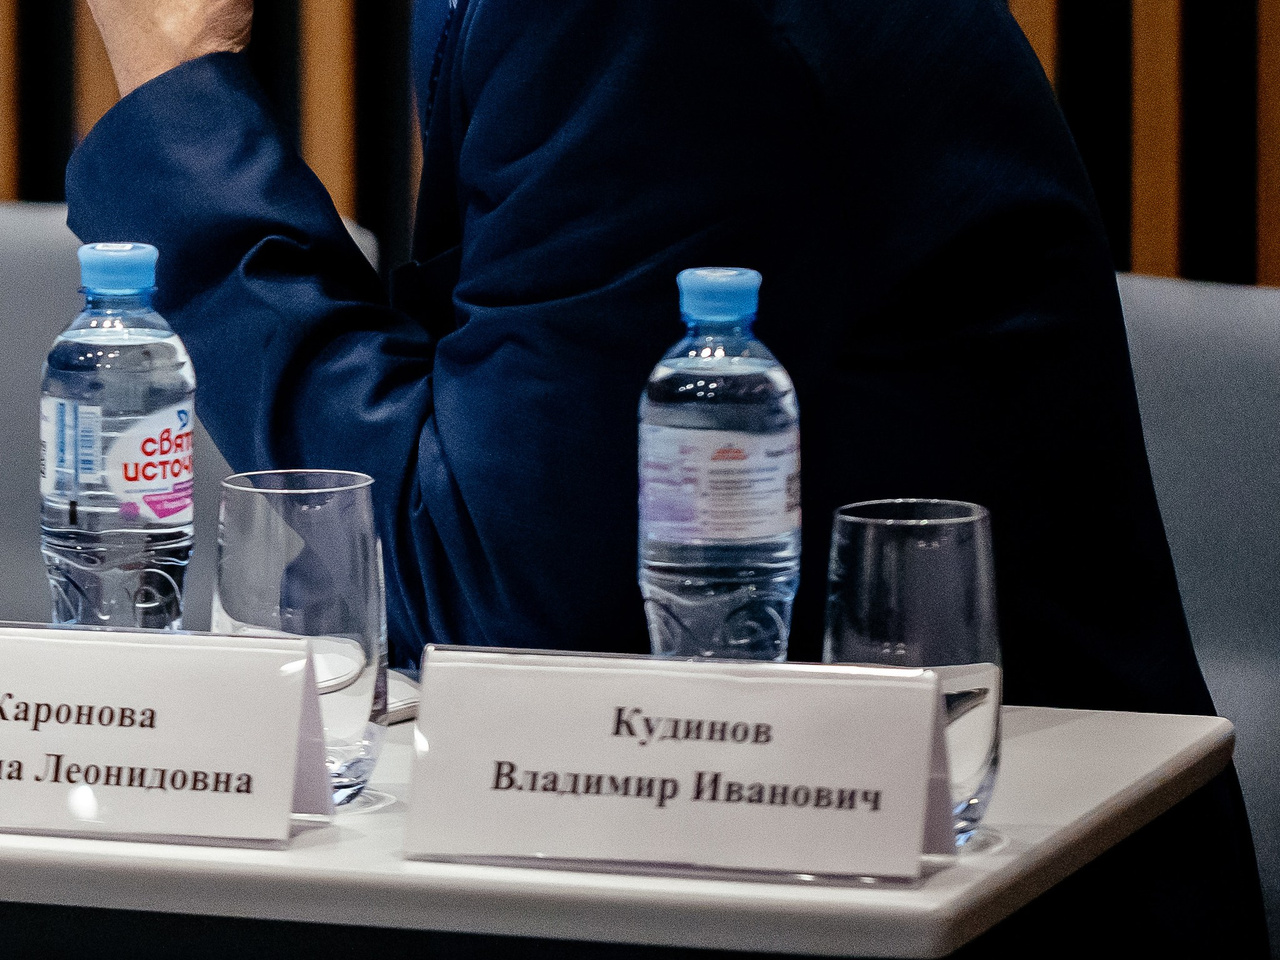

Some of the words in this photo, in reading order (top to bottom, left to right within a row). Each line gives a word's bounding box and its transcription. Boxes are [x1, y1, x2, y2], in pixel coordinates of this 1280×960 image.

[141, 428, 193, 457] СВЯТ
[122, 455, 193, 482] ИСТОЧ
[612, 706, 773, 746] Кудинов
[33, 753, 254, 795] Леонидовна
[490, 760, 680, 810] Владимир
[692, 771, 883, 813] Иванович
